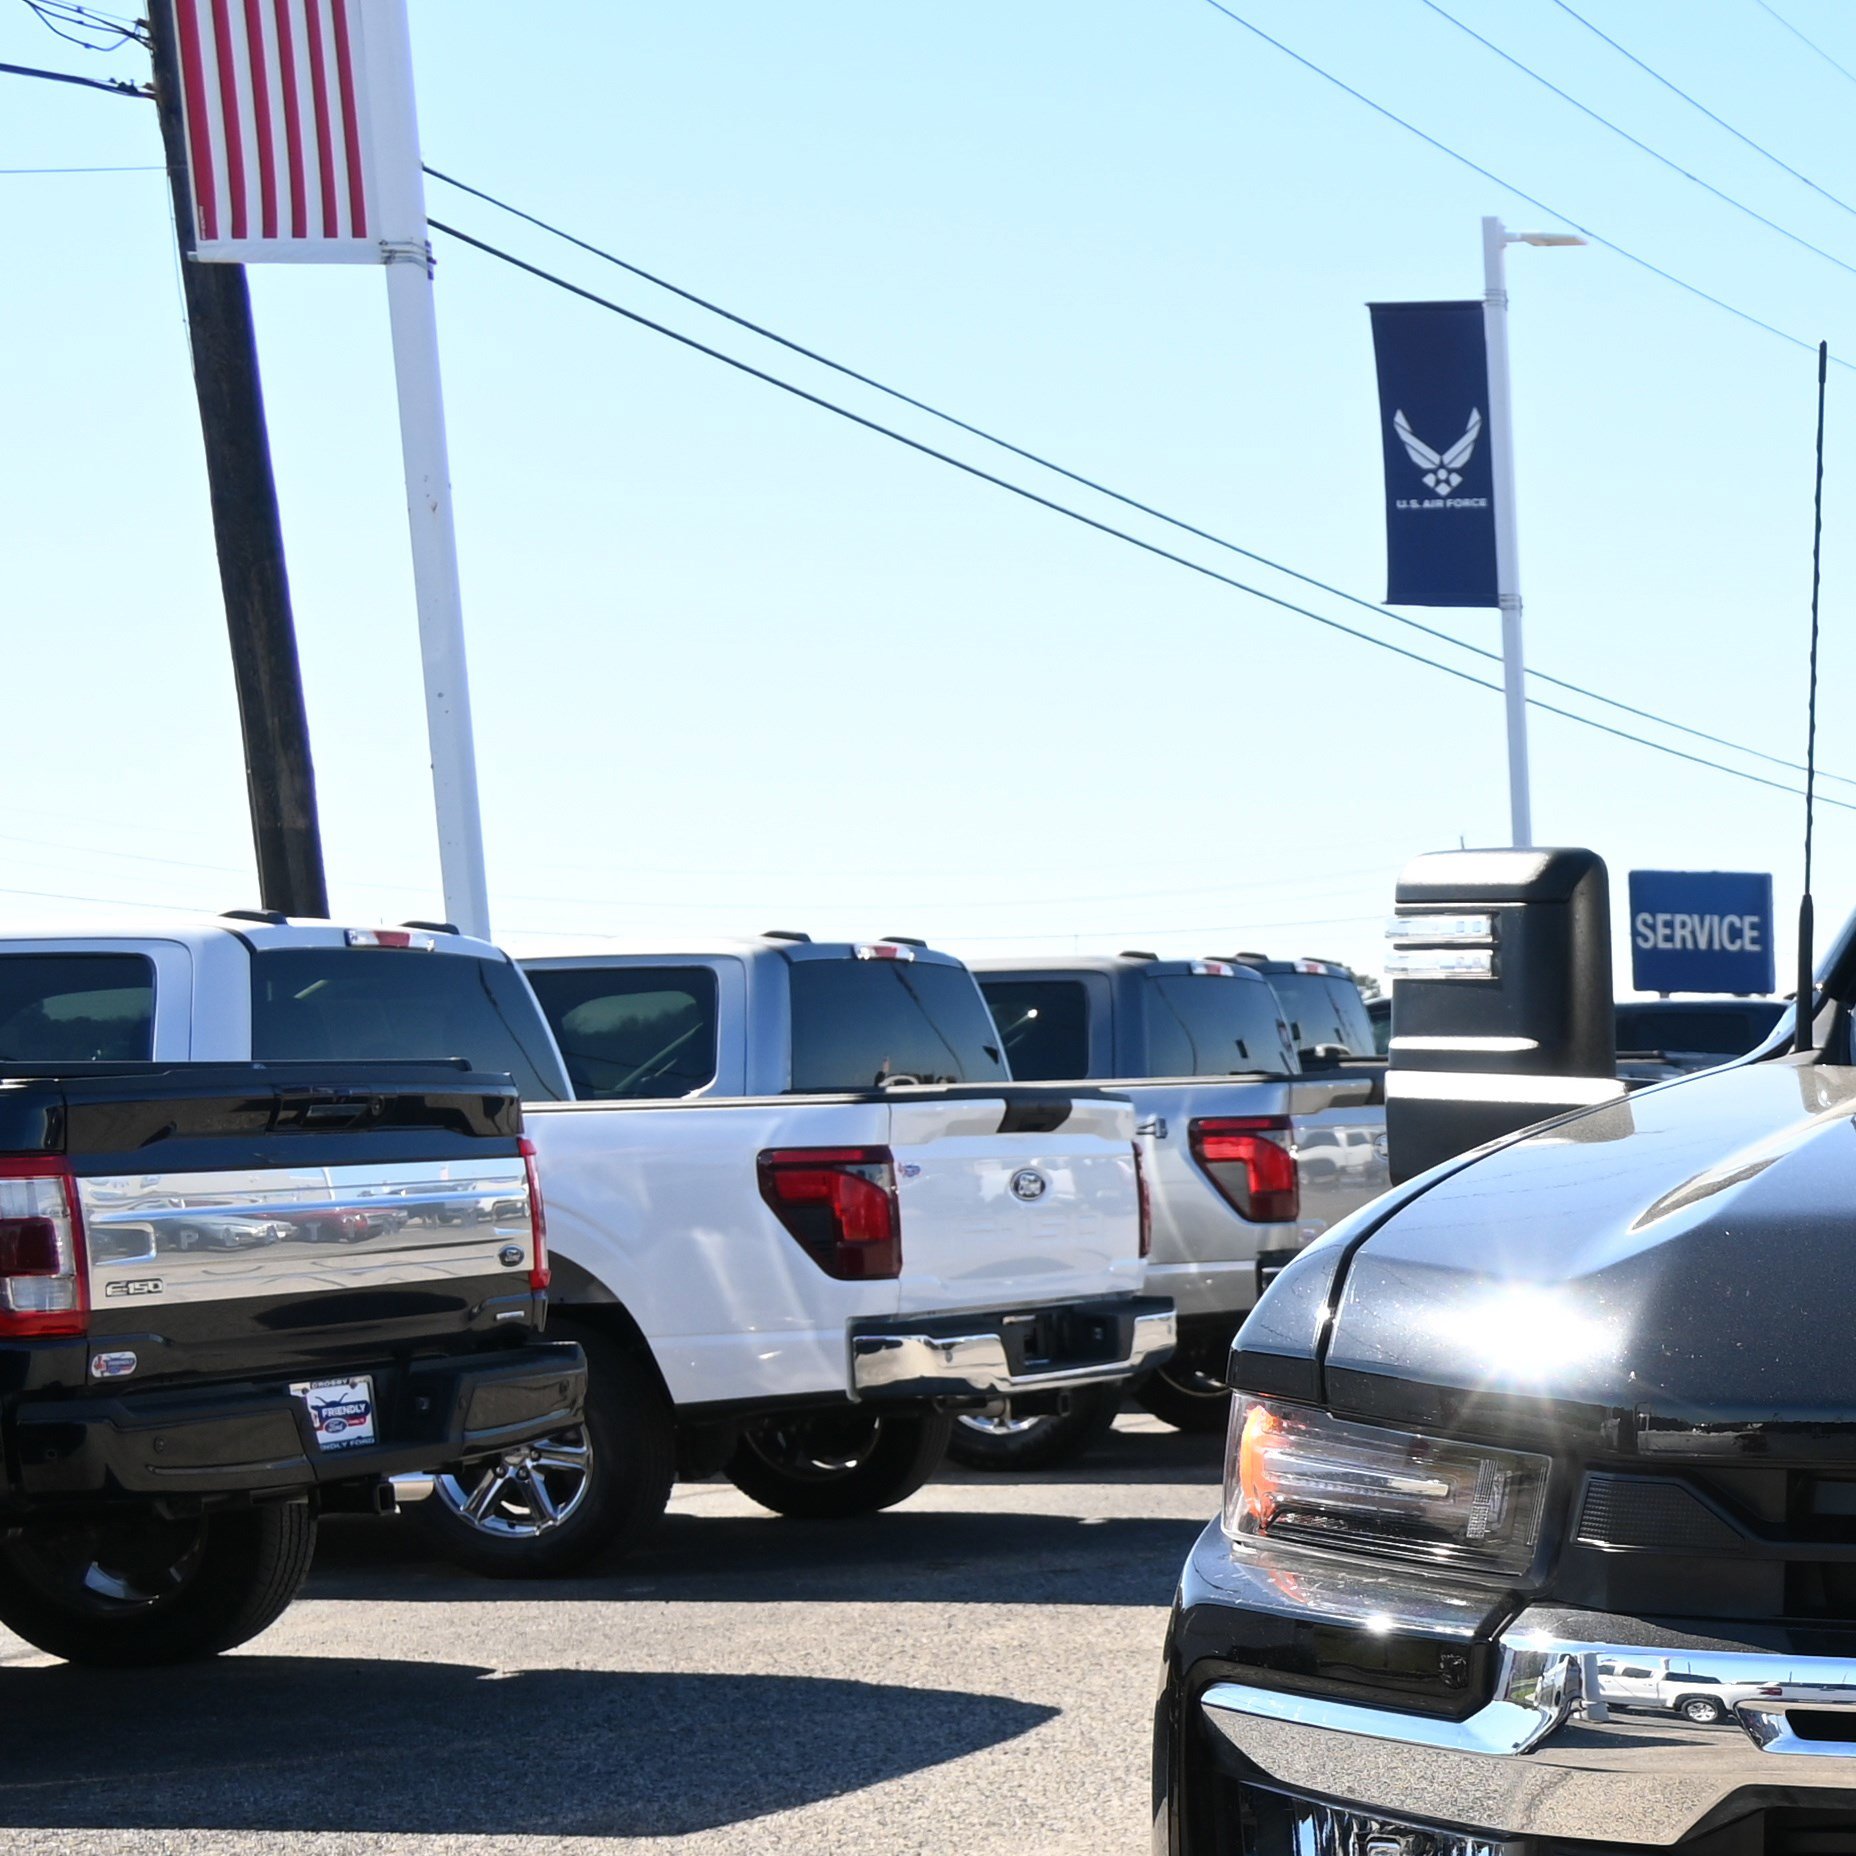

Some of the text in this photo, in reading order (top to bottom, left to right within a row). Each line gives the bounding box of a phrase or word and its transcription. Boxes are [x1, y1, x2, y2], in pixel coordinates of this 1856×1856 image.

[1422, 499, 1444, 509] AIR
[1446, 498, 1487, 508] FORCE
[1635, 911, 1762, 951] SERVICE
[105, 1279, 163, 1297] F-150
[322, 1403, 366, 1419] FRIENDLY
